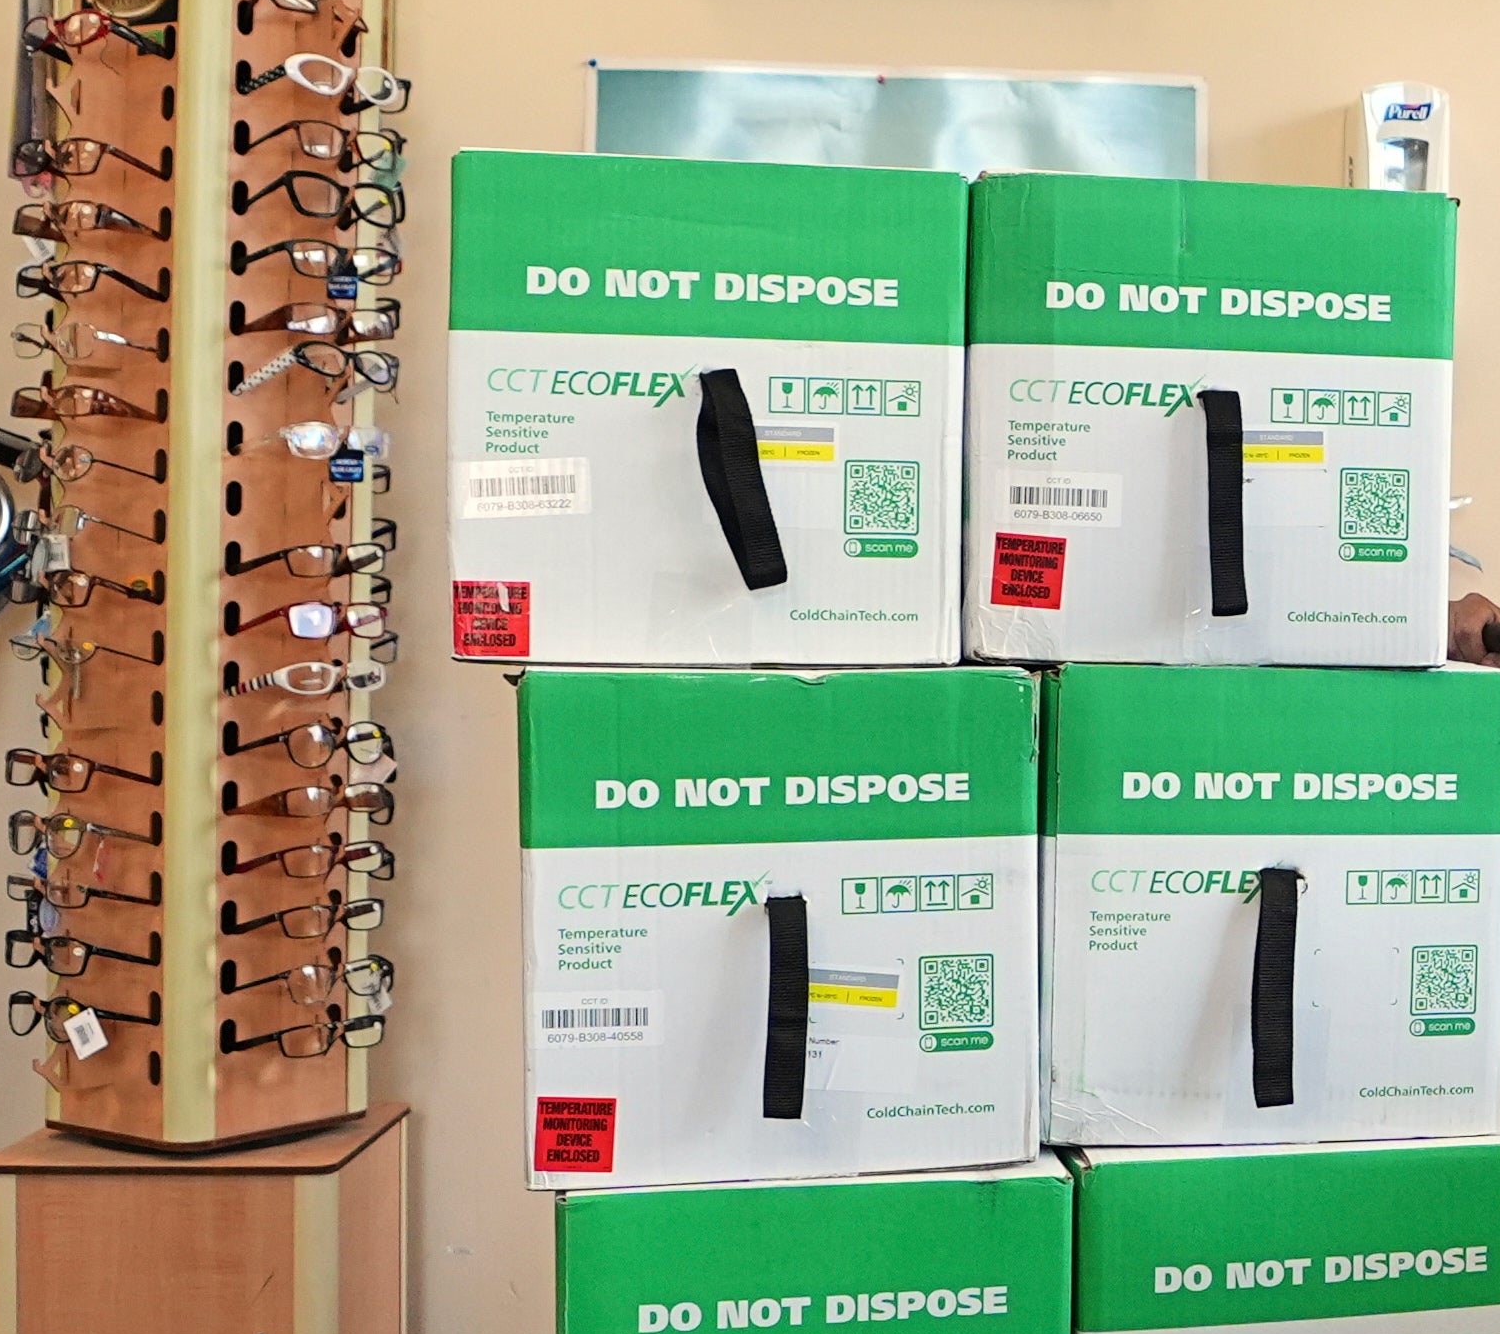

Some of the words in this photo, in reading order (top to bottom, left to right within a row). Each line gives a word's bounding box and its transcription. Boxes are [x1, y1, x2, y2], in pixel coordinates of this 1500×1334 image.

[1388, 106, 1429, 120] Purell
[525, 265, 590, 297] DO
[605, 268, 700, 300] NOT
[714, 272, 899, 307] DISPOSE
[1046, 281, 1107, 310] DO
[1119, 285, 1207, 315] NOT
[1220, 288, 1392, 322] DISPOSE
[487, 367, 548, 394] CCT
[550, 365, 697, 408] ECOFLEX
[1008, 377, 1065, 404] CCT
[1067, 374, 1206, 418] ECOFLEX
[486, 411, 575, 427] Temperature
[485, 426, 549, 439] Sensitive
[1007, 420, 1091, 436] Temperature
[485, 440, 540, 455] Product
[1007, 435, 1067, 448] Sensitive
[1007, 449, 1058, 462] Product
[1013, 509, 1103, 522] 6079-B308-06650
[865, 543, 892, 554] scan
[894, 543, 914, 554] me
[996, 537, 1065, 554] TEMPERATURE
[1357, 548, 1385, 558] scan
[1387, 549, 1403, 558] me
[999, 553, 1059, 570] MONITORING
[1010, 569, 1045, 584] DEVICE
[1001, 584, 1051, 601] ENCLOSED
[789, 608, 919, 624] ColdChainTech.com
[1287, 610, 1408, 625] ColdChainTech.com
[595, 779, 660, 809] DO
[675, 777, 770, 808] NOT
[785, 772, 970, 806] DISPOSE
[1122, 771, 1181, 800] DO
[1194, 772, 1281, 801] NOT
[1293, 772, 1458, 801] DISPOSE
[1091, 869, 1140, 894] CCT
[557, 883, 619, 910] CCT
[622, 871, 770, 916] ECOFLEX
[558, 927, 649, 942] Temperature
[558, 942, 622, 956] Sensitive
[558, 957, 613, 971] Product
[547, 1030, 644, 1043] 6079-B308-40558
[939, 1036, 967, 1046] scan
[969, 1035, 989, 1045] me
[1359, 1084, 1474, 1098] ColdChainTech.com
[538, 1101, 614, 1116] TEMPERATURE
[866, 1101, 995, 1120] ColdChainTech.com
[542, 1117, 608, 1132] MONITORING
[556, 1133, 593, 1148] DEVICE
[546, 1148, 600, 1164] ENCLOSED
[1154, 1264, 1212, 1294] DO
[1226, 1258, 1312, 1289] NOT
[1324, 1246, 1488, 1284] DISPOSE
[638, 1302, 702, 1333] DO
[716, 1295, 812, 1329] NOT
[825, 1286, 1008, 1325] DISPOSE
